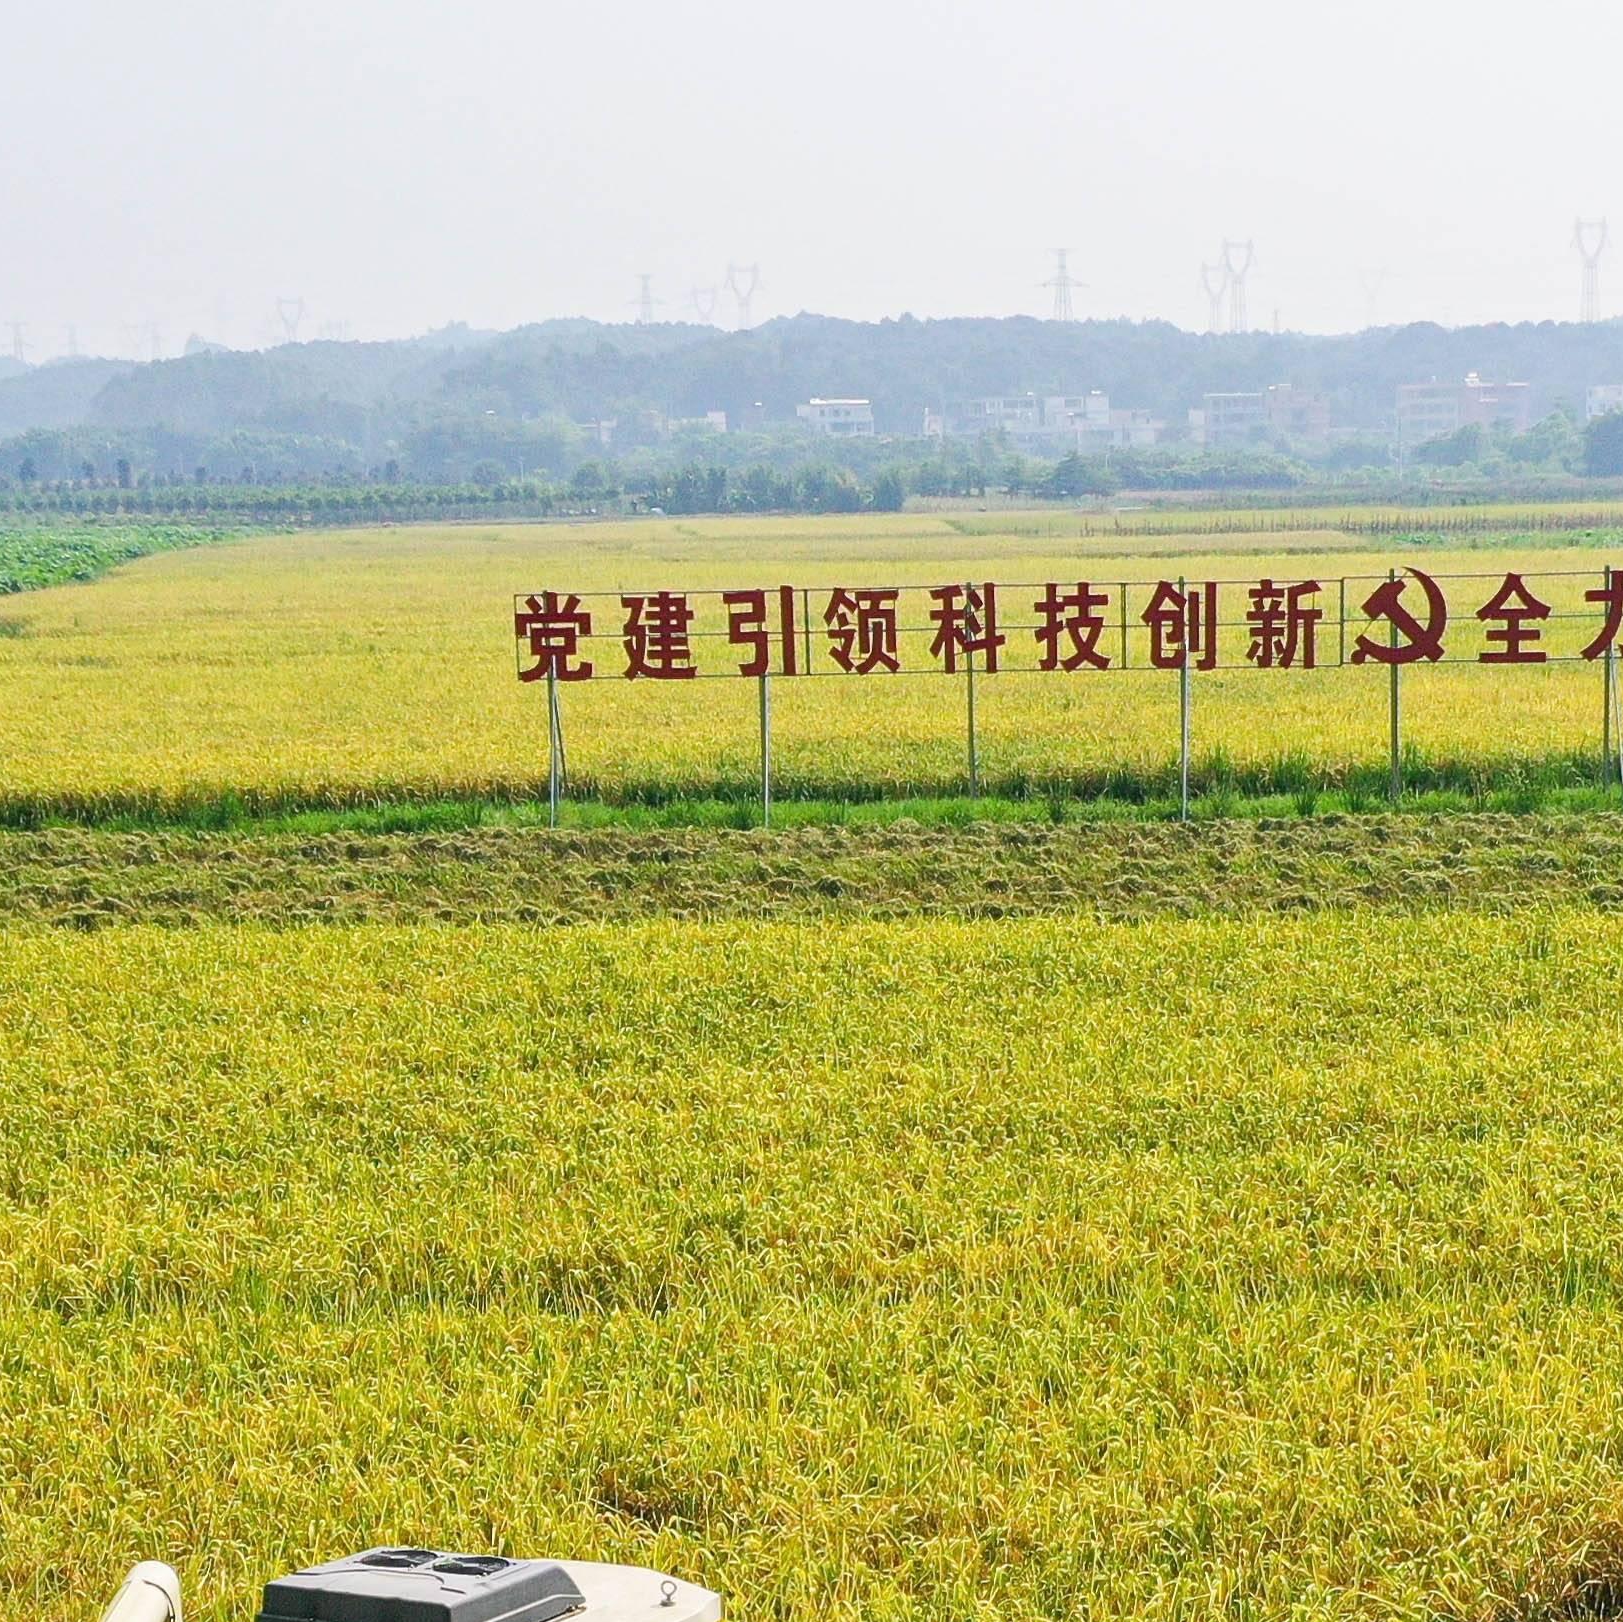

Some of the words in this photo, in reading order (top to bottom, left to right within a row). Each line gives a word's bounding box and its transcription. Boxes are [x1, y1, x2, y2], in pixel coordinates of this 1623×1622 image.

[515, 579, 1324, 682] 党建引领科技创新
